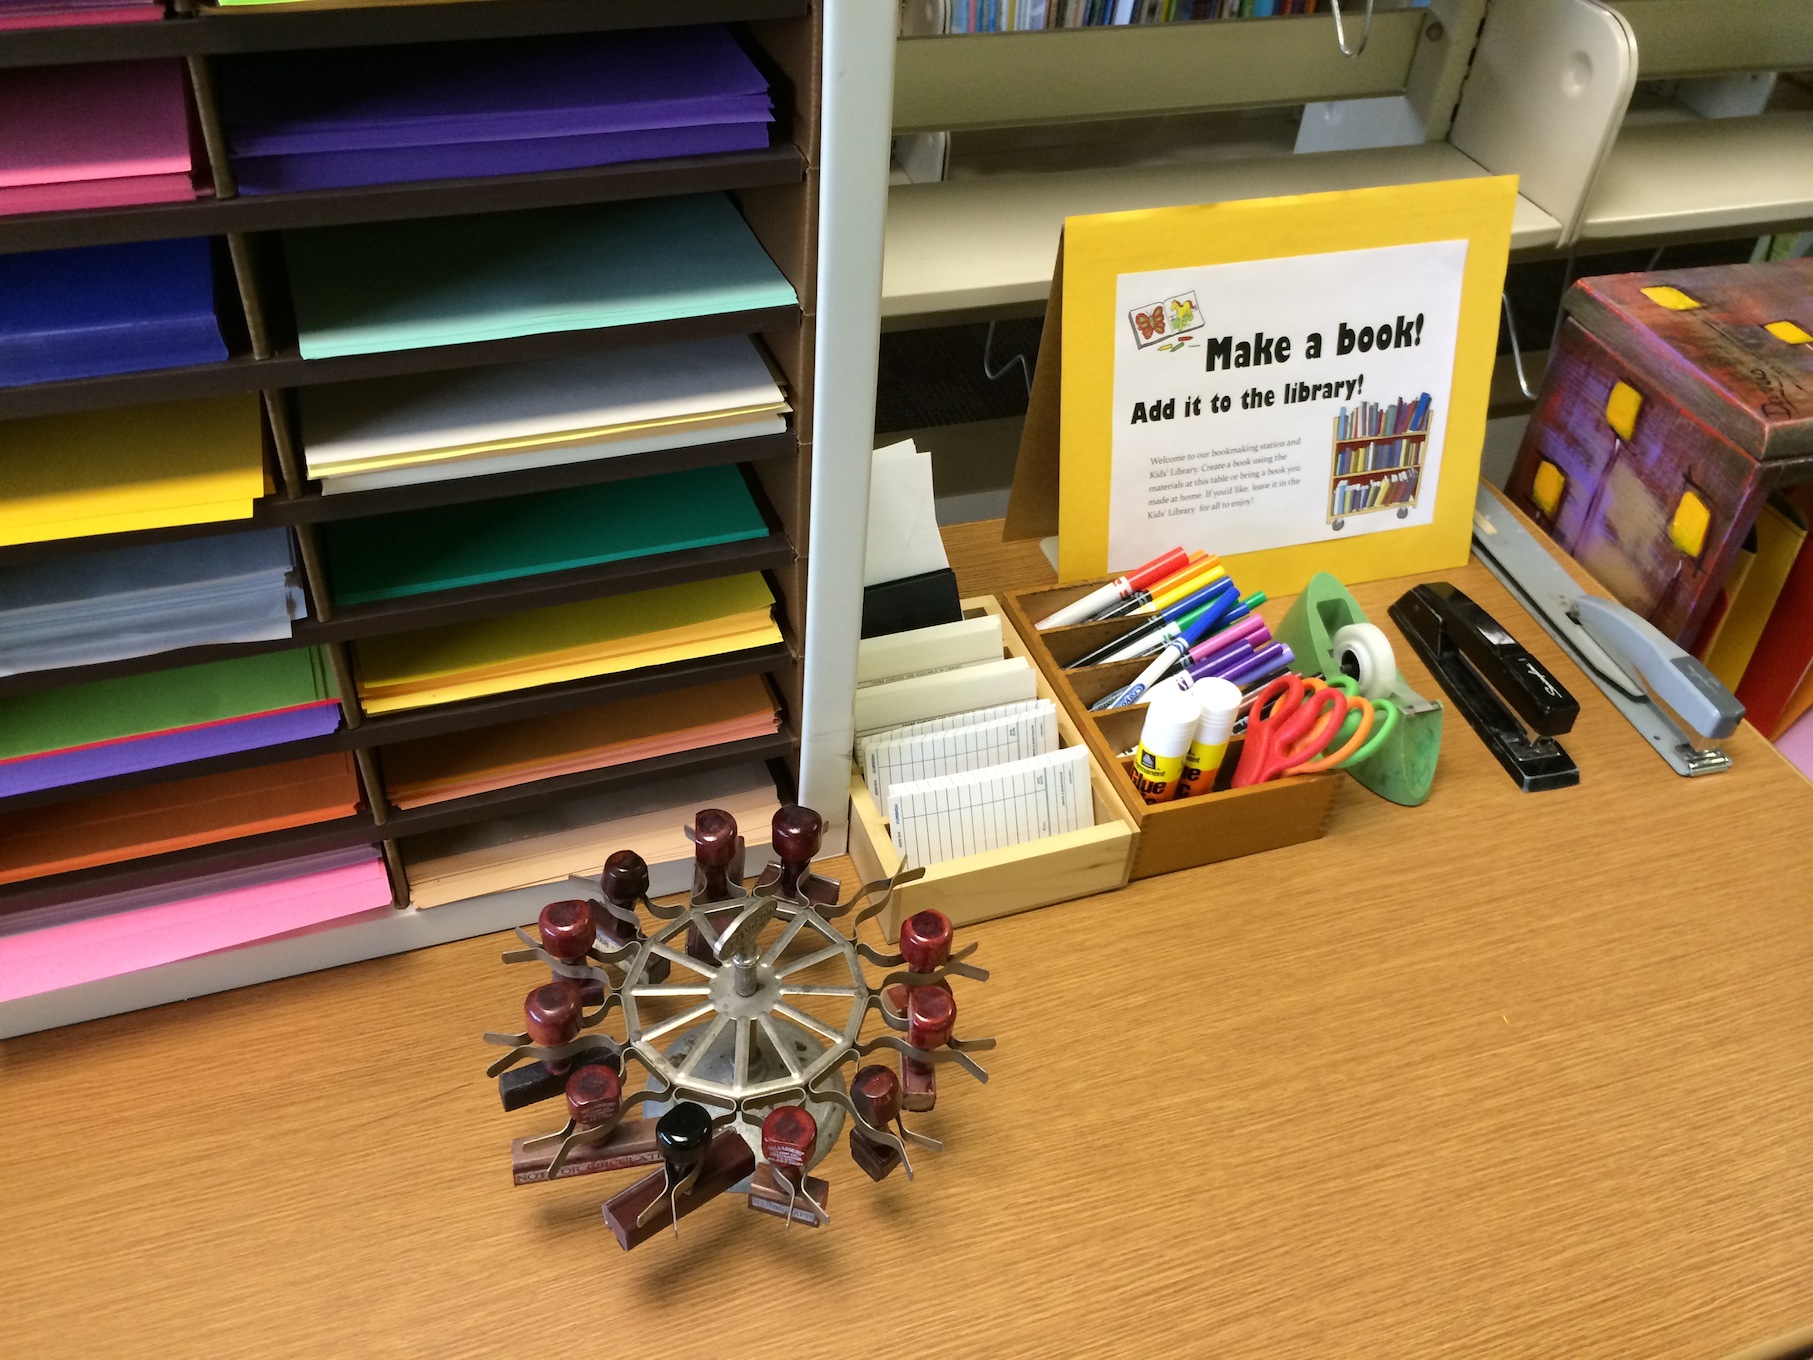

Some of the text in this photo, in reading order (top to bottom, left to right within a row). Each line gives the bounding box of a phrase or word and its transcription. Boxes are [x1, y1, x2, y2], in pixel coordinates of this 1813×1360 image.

[1205, 313, 1424, 372] Make a book!
[1131, 374, 1364, 424] Add it to the library!
[1150, 454, 1185, 465] Welcome
[1212, 444, 1258, 457] bookmaking
[1260, 441, 1285, 450] station
[1287, 437, 1301, 447] and
[1149, 480, 1184, 492] materials
[1195, 476, 1208, 486] this
[1210, 474, 1228, 483] table
[1240, 470, 1260, 479] bring
[1268, 466, 1286, 475] book
[1287, 466, 1301, 474] you
[1150, 469, 1169, 479] Kids'
[1201, 463, 1225, 472] Create
[1233, 459, 1251, 467] book
[1253, 456, 1273, 465] using
[1274, 453, 1287, 462] the
[1148, 495, 1169, 506] made
[1180, 491, 1203, 501] home.
[1205, 490, 1212, 498] If
[1213, 486, 1232, 497] you'd
[1252, 481, 1270, 491] leave
[1271, 479, 1277, 487] it
[1279, 478, 1286, 486] in
[1288, 476, 1301, 486] the
[1148, 508, 1167, 519] Kids'
[1169, 504, 1196, 516] Library
[1199, 502, 1209, 512] for
[1211, 500, 1220, 509] all
[1222, 500, 1229, 508] to
[516, 1151, 664, 1184] NOT OR CIRCULATI
